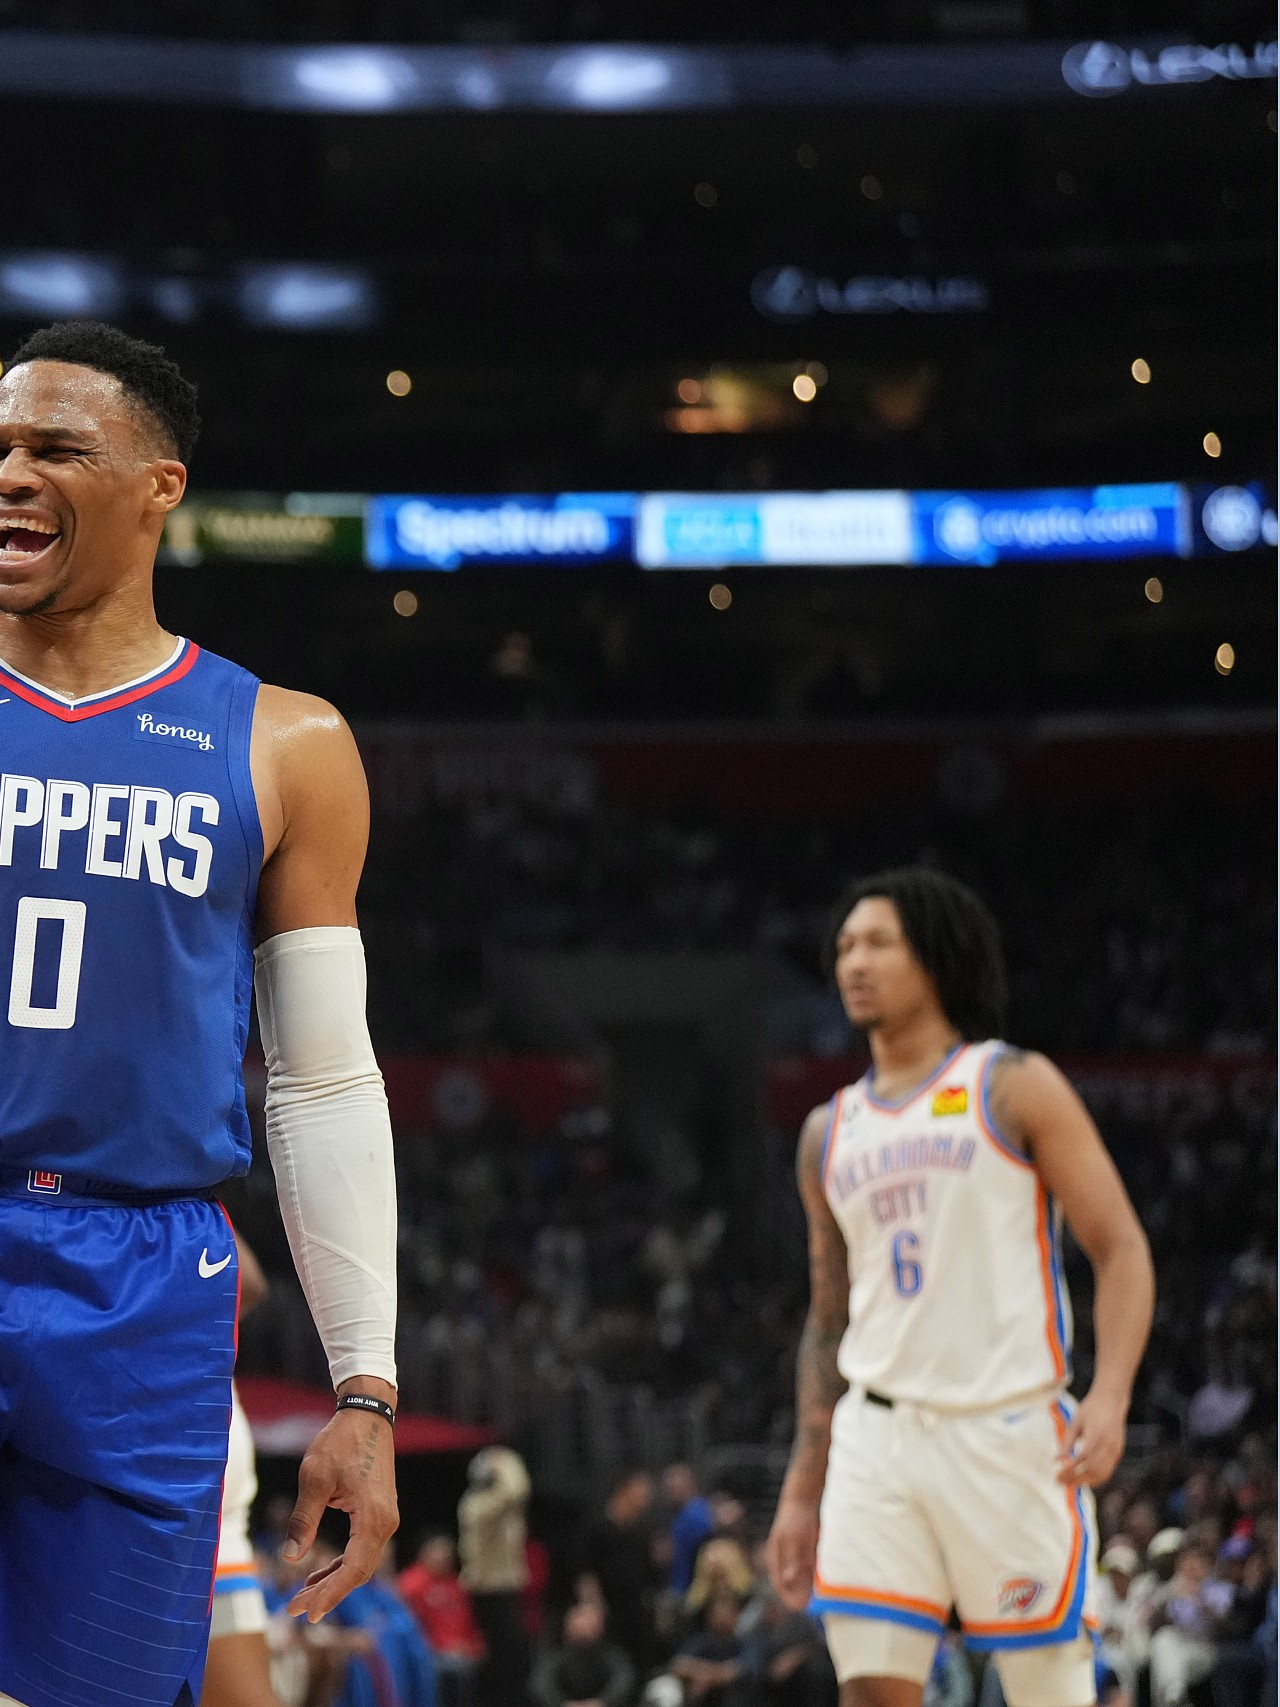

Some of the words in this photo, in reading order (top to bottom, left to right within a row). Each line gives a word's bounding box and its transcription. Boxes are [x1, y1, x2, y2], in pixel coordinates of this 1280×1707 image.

[137, 713, 215, 750] honey
[8, 896, 87, 1029] 0
[892, 1230, 923, 1298] 6
[364, 1399, 379, 1408] WHY
